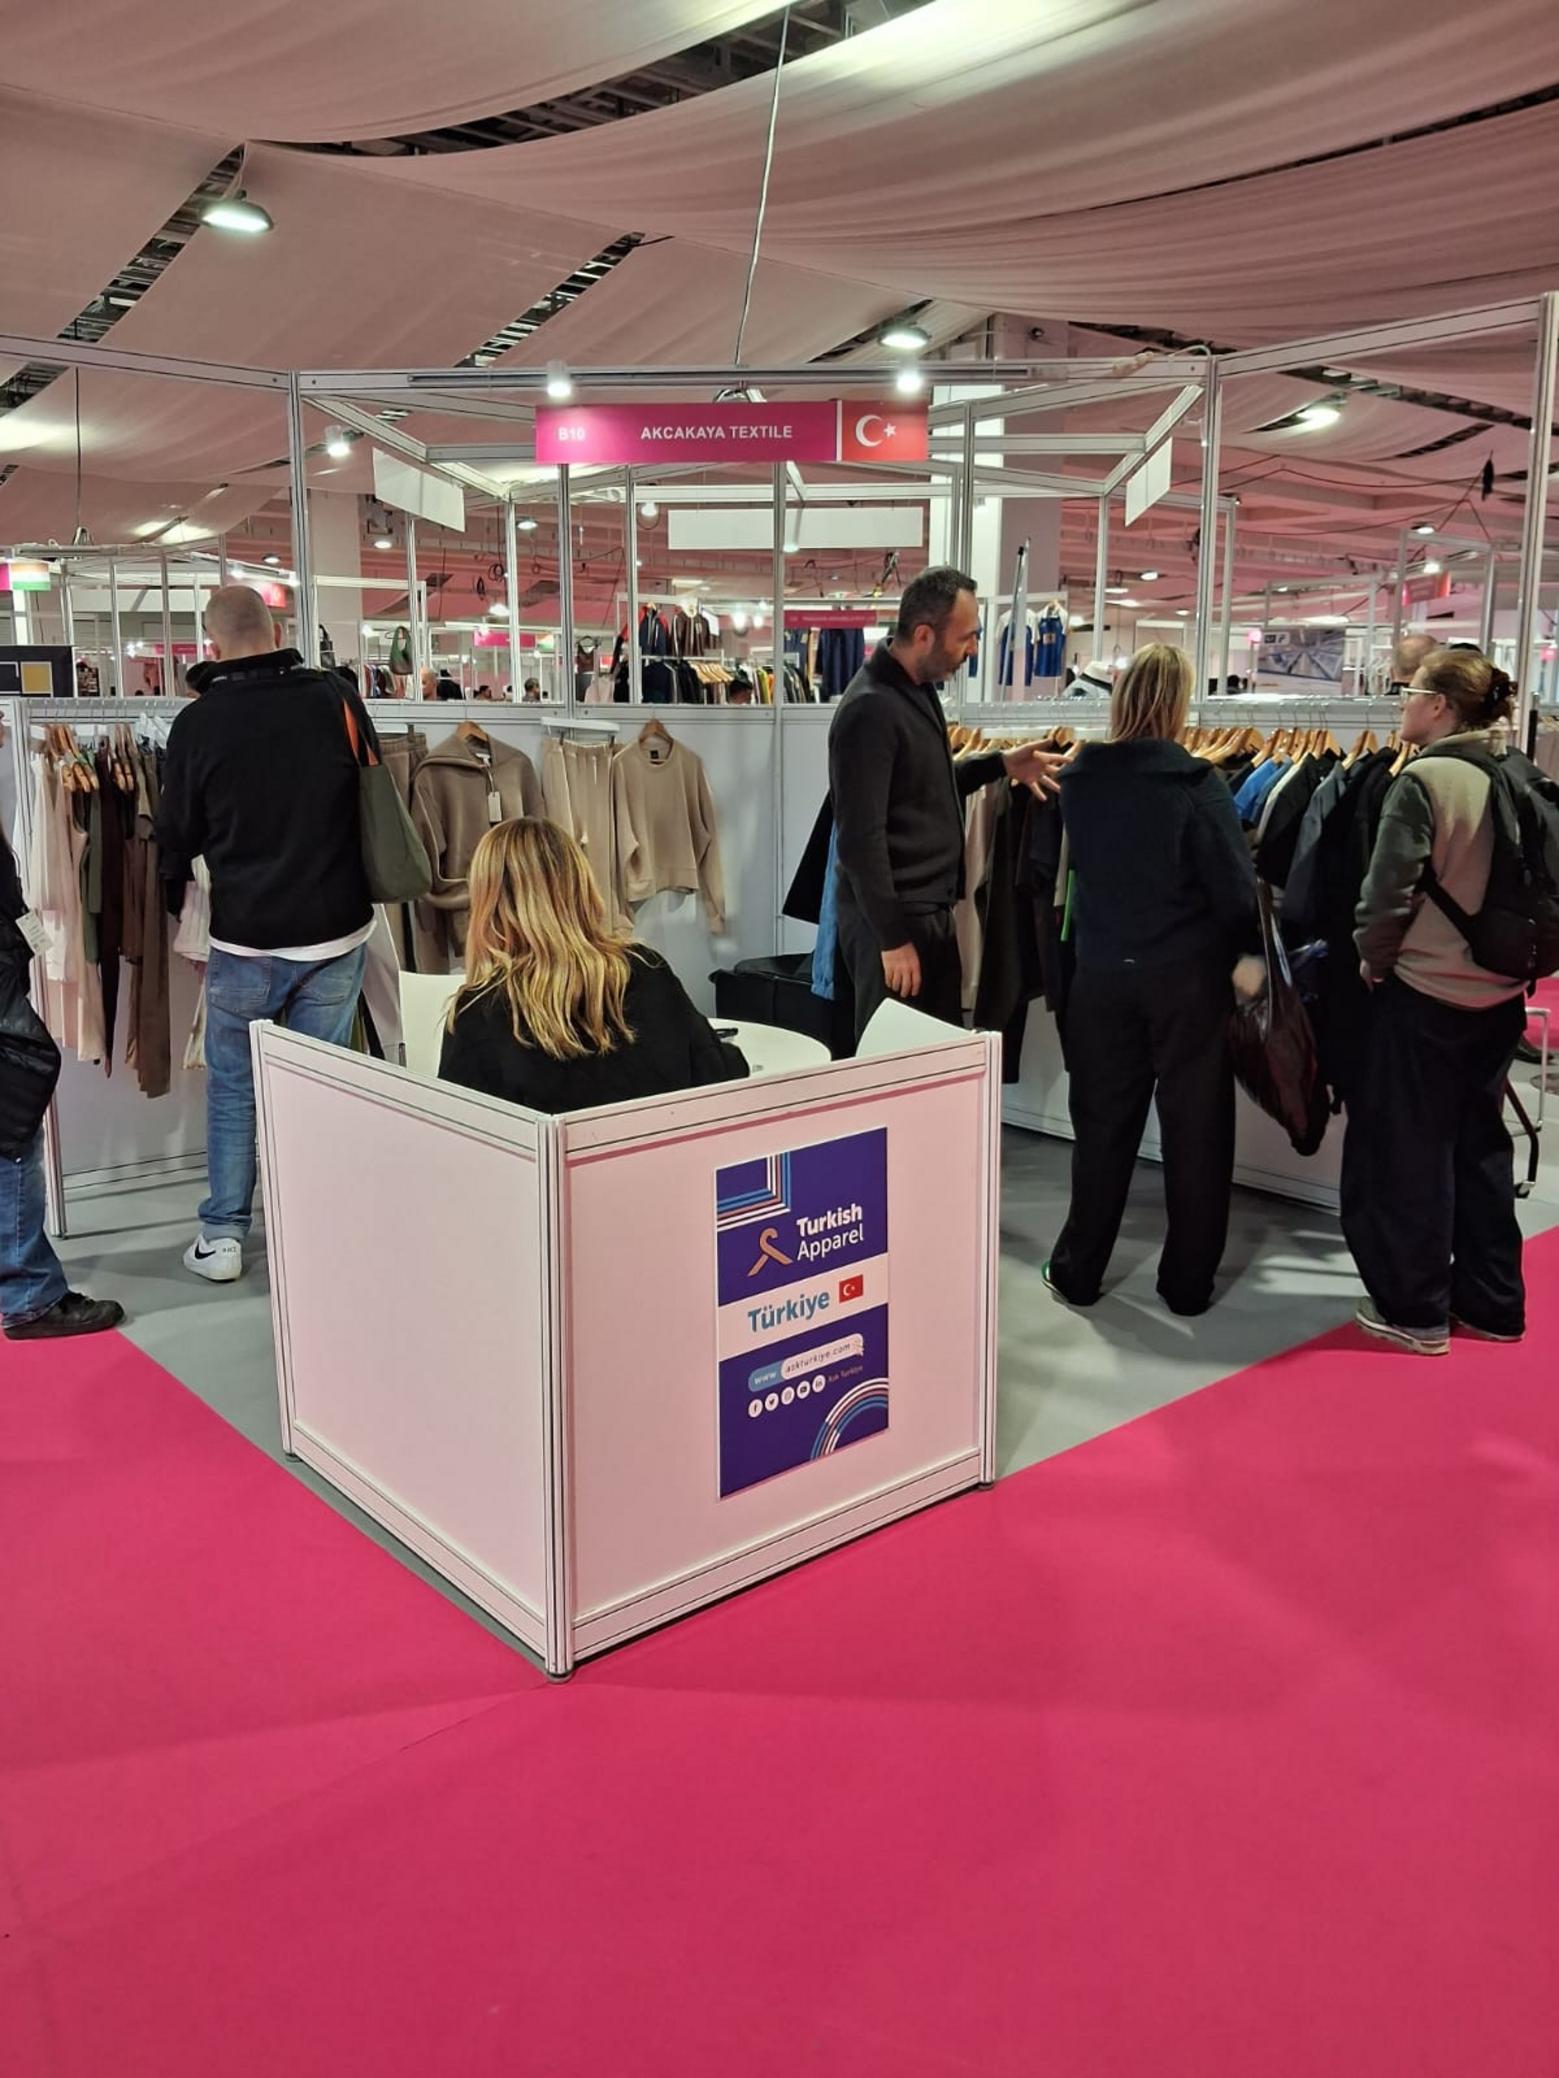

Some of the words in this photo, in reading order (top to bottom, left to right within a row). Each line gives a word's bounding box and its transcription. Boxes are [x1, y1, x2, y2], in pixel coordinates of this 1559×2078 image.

[558, 426, 586, 440] B10
[640, 426, 726, 440] AKCAKAYA
[729, 425, 793, 439] TEXTILE
[796, 1203, 863, 1238] Turkish
[796, 1223, 864, 1262] Apparel
[747, 1291, 830, 1333] Türkiye
